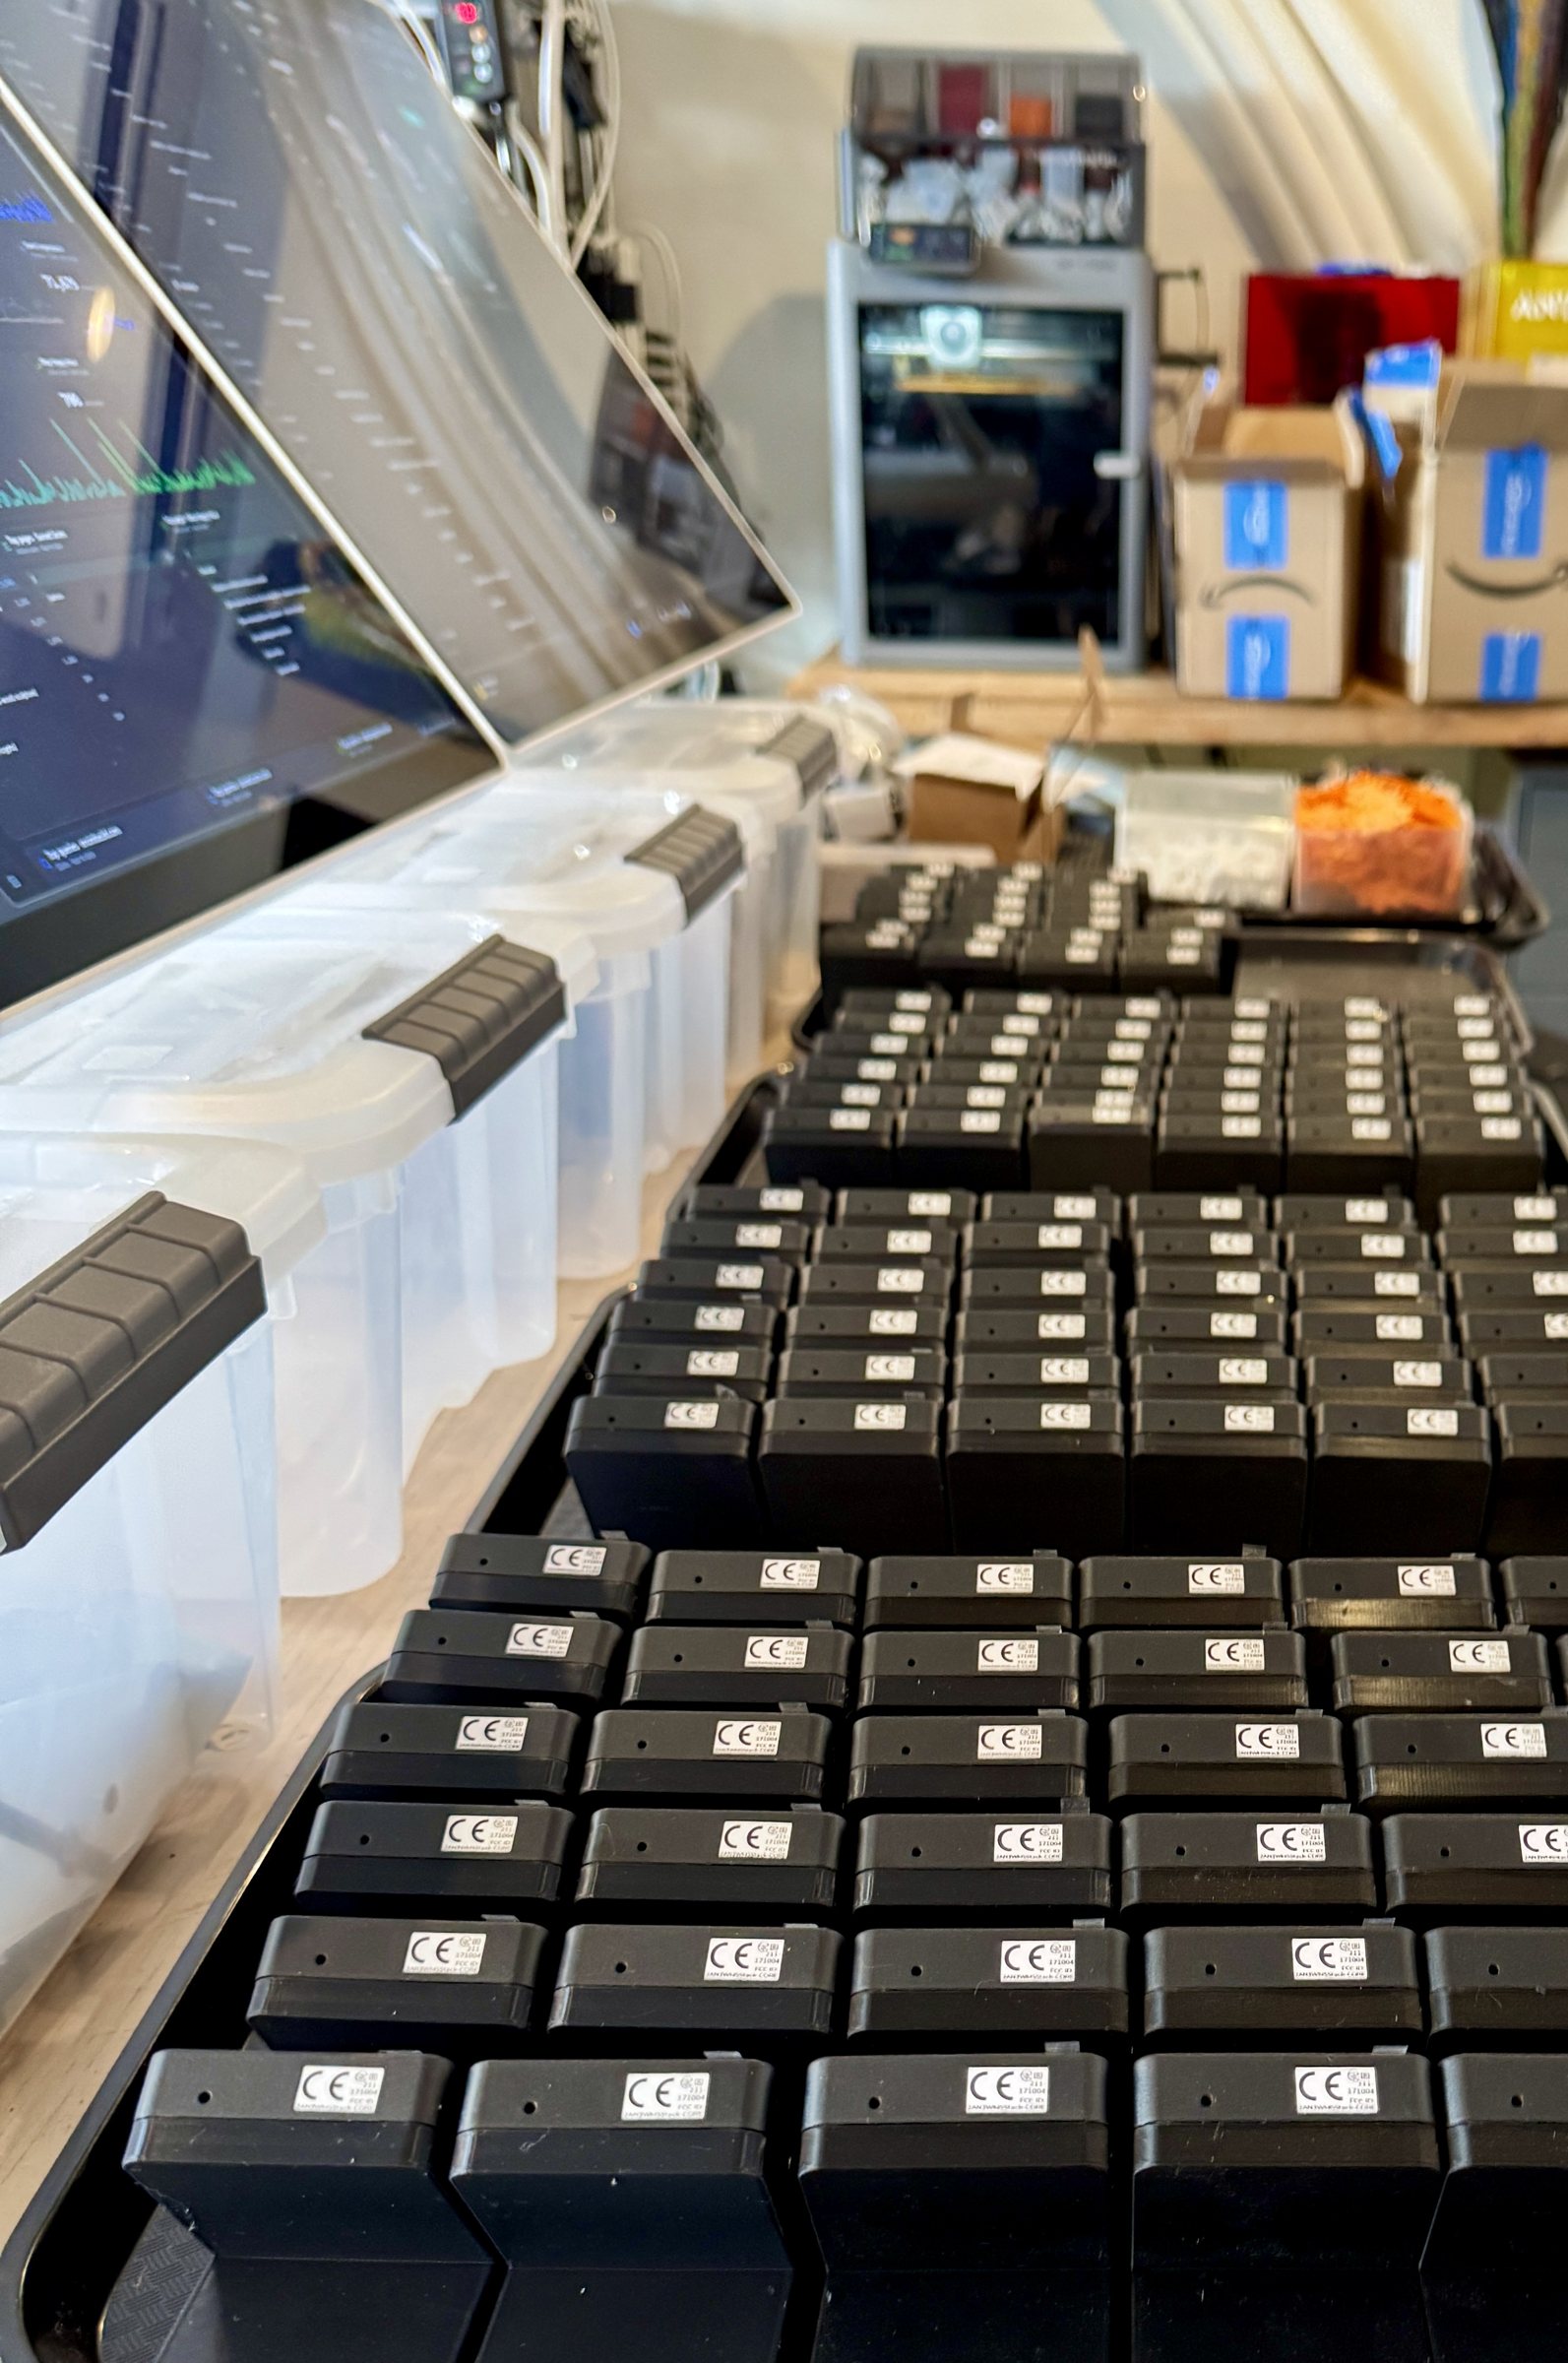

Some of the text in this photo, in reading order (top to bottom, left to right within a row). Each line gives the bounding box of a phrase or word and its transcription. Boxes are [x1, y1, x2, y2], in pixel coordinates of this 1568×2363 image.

[550, 1548, 584, 1567] CE
[764, 1562, 796, 1581] CE
[979, 1566, 1011, 1585] CE
[1191, 1566, 1222, 1585] CE
[1401, 1568, 1432, 1587] CE
[513, 1626, 548, 1647] CE
[749, 1638, 784, 1659] CE
[980, 1642, 1014, 1663] CE
[1207, 1641, 1240, 1662] CE
[1452, 1643, 1485, 1663] CE
[463, 1718, 501, 1742] CE
[718, 1723, 754, 1746] CE
[980, 1728, 1016, 1750] CE
[1237, 1727, 1273, 1749] CE
[1484, 1727, 1520, 1749] CE
[448, 1818, 489, 1843] CE
[723, 1824, 763, 1849] CE
[997, 1827, 1035, 1852] CE
[1259, 1826, 1297, 1851] CE
[1523, 1828, 1562, 1852] CE
[410, 1936, 455, 1964] CE
[710, 1942, 753, 1969] CE
[1004, 1944, 1045, 1971] CE
[1294, 1942, 1336, 1969] CE
[302, 2070, 350, 2101] CE
[628, 2076, 675, 2108] CE
[970, 2071, 1015, 2101] CE
[1298, 2071, 1344, 2101] CE
